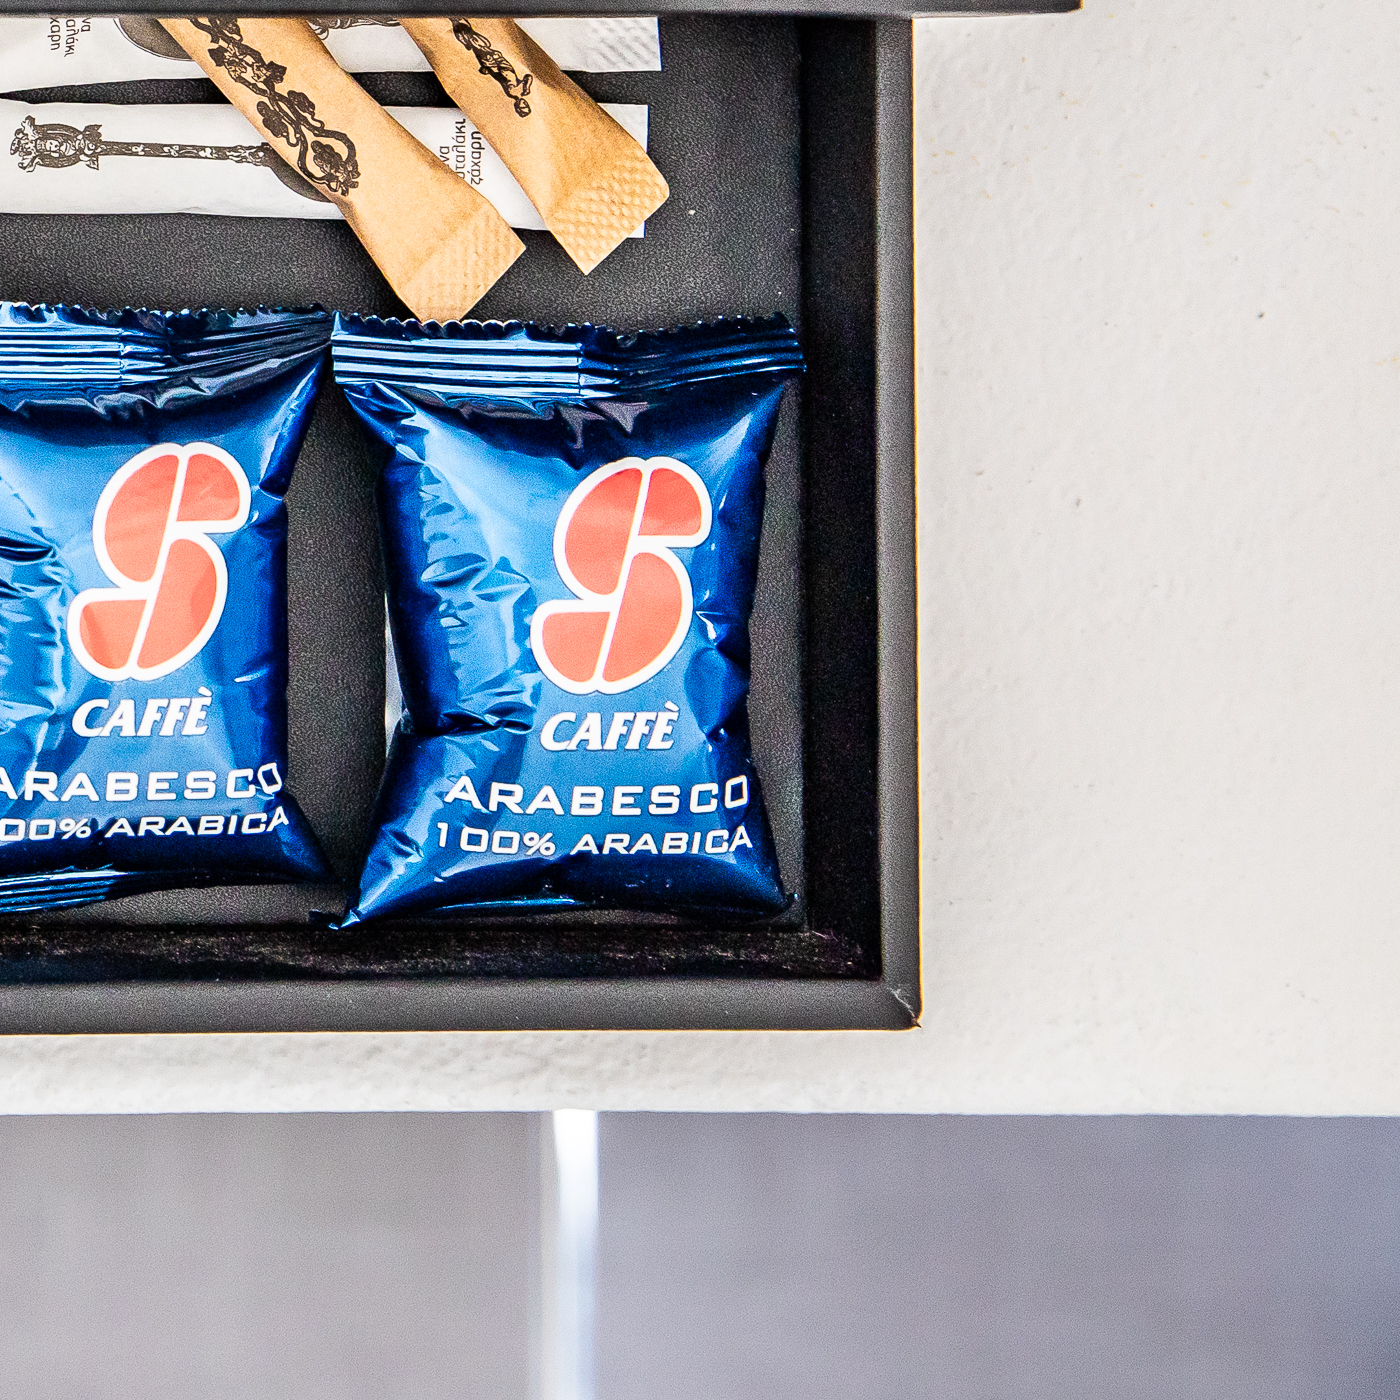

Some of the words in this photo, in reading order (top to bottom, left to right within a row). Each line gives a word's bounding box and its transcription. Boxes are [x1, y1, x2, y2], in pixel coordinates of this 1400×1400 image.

[467, 131, 486, 186] ζάχαρη
[71, 686, 213, 737] CAFFÈ
[540, 700, 680, 751] CAFFÈ
[444, 774, 749, 817] ARABESCO
[104, 806, 289, 838] ARABICA
[436, 821, 556, 856] 100%
[569, 825, 753, 855] ARABICA
